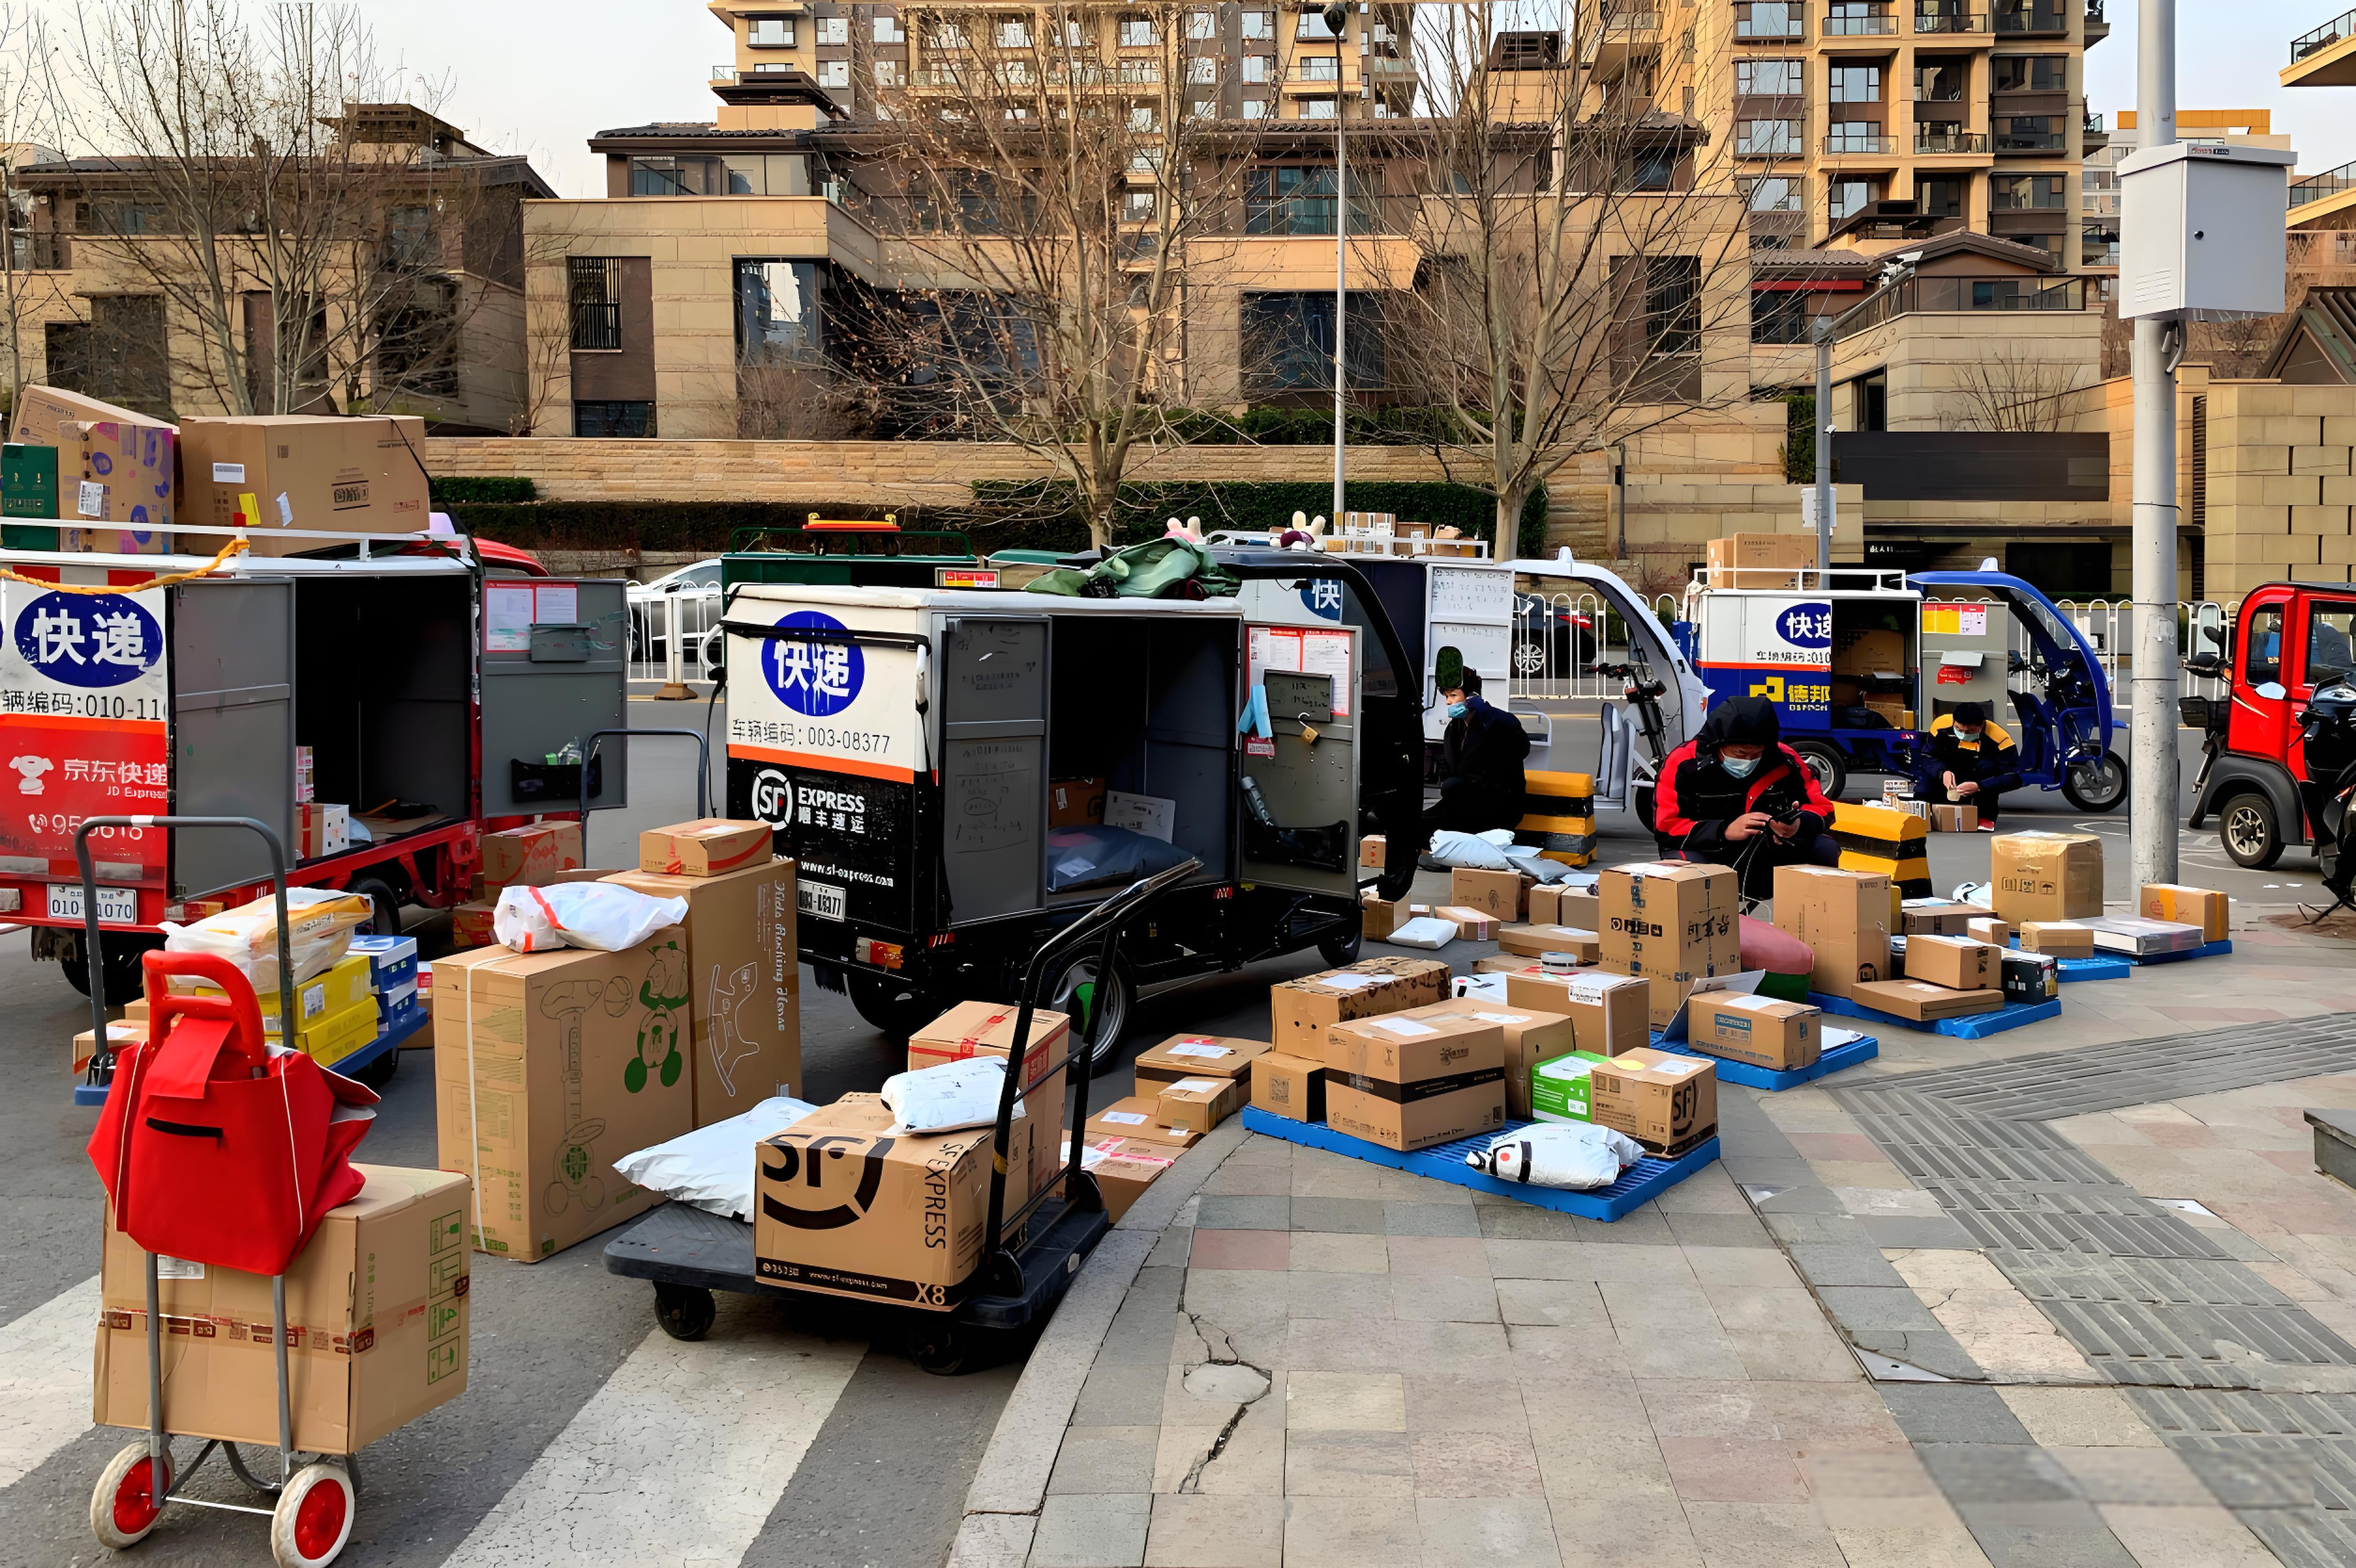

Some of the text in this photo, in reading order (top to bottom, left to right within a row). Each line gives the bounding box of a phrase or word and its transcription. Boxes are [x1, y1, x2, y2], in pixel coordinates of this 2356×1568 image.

[1312, 579, 1340, 609] 快
[32, 608, 146, 665] 快递
[774, 639, 850, 697] 快递
[1788, 685, 1830, 703] 德邦
[64, 759, 167, 786] 京东快递
[107, 786, 120, 796] JD
[798, 786, 865, 813] EXPRESS
[924, 1159, 949, 1249] EXPRESS
[914, 1282, 945, 1305] X8
